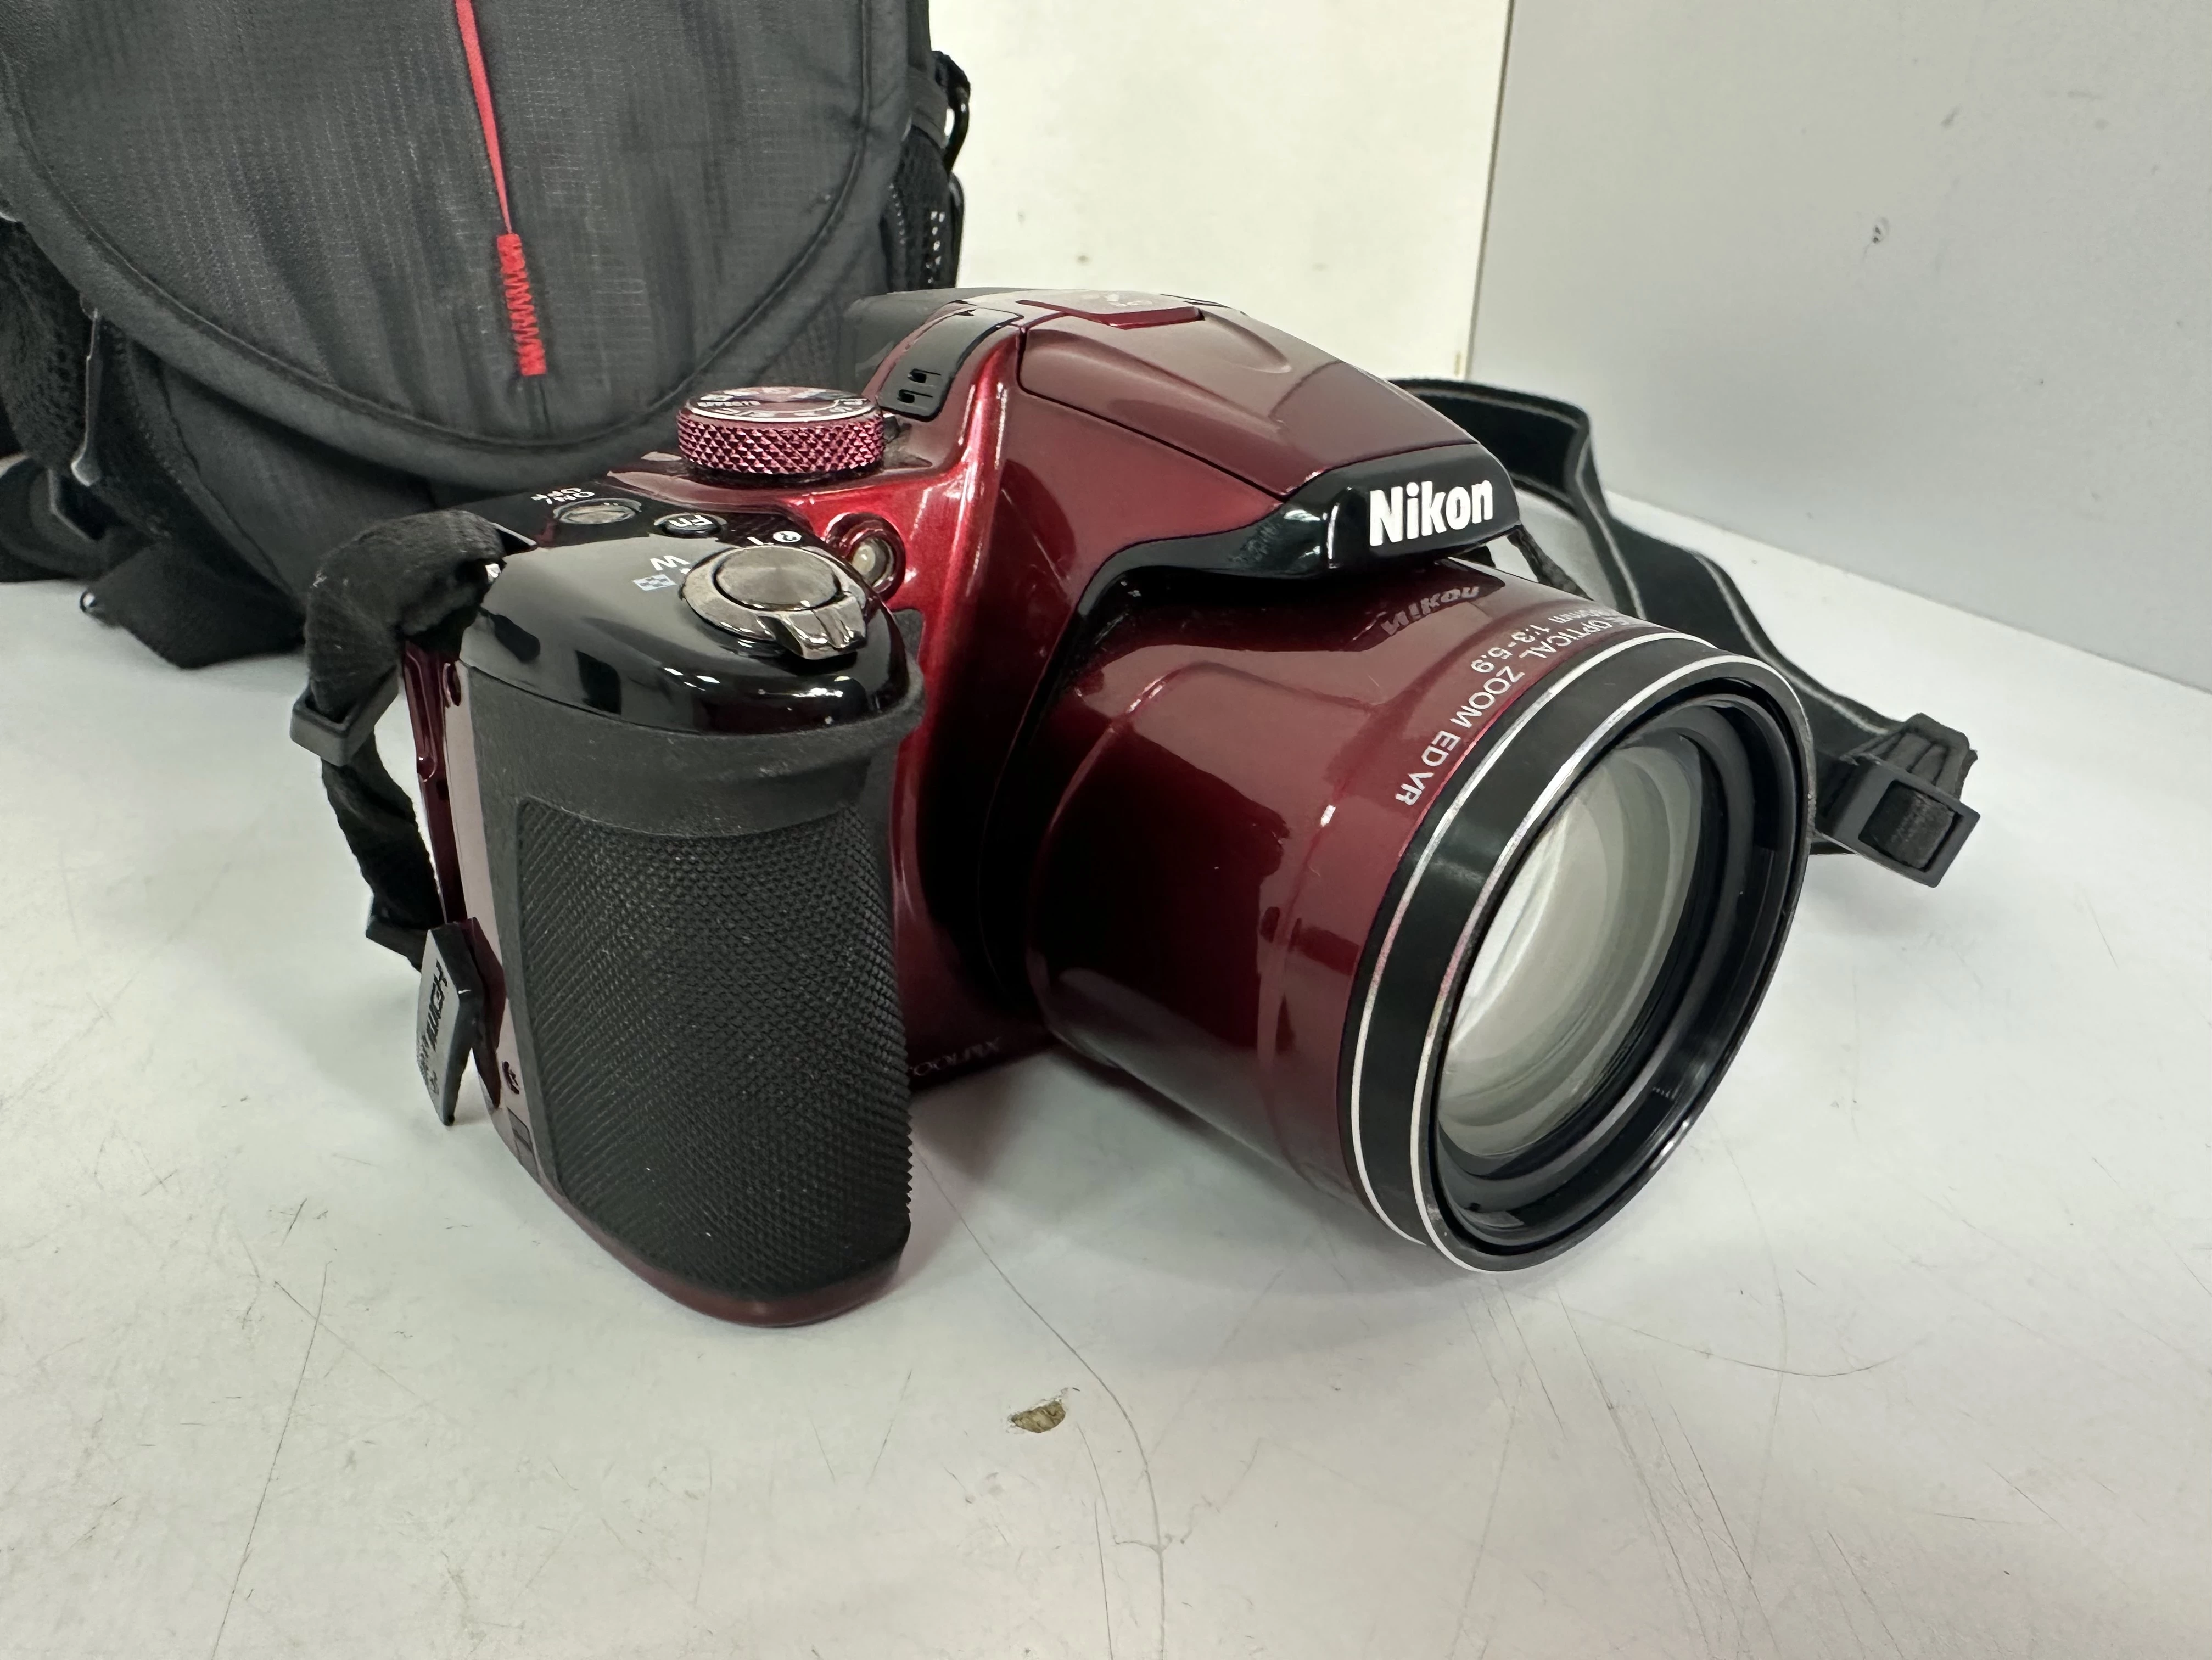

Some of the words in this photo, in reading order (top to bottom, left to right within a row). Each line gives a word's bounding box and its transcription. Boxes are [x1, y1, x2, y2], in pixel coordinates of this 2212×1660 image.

[668, 514, 713, 528] Fn
[1369, 479, 1493, 547] Nikon
[649, 554, 690, 571] W
[1470, 625, 1550, 673] 1:3-5.9
[1519, 619, 1613, 659] OPTICAL
[1449, 665, 1526, 728] ZOOM
[1421, 730, 1461, 767] ED
[1395, 772, 1435, 806] VR
